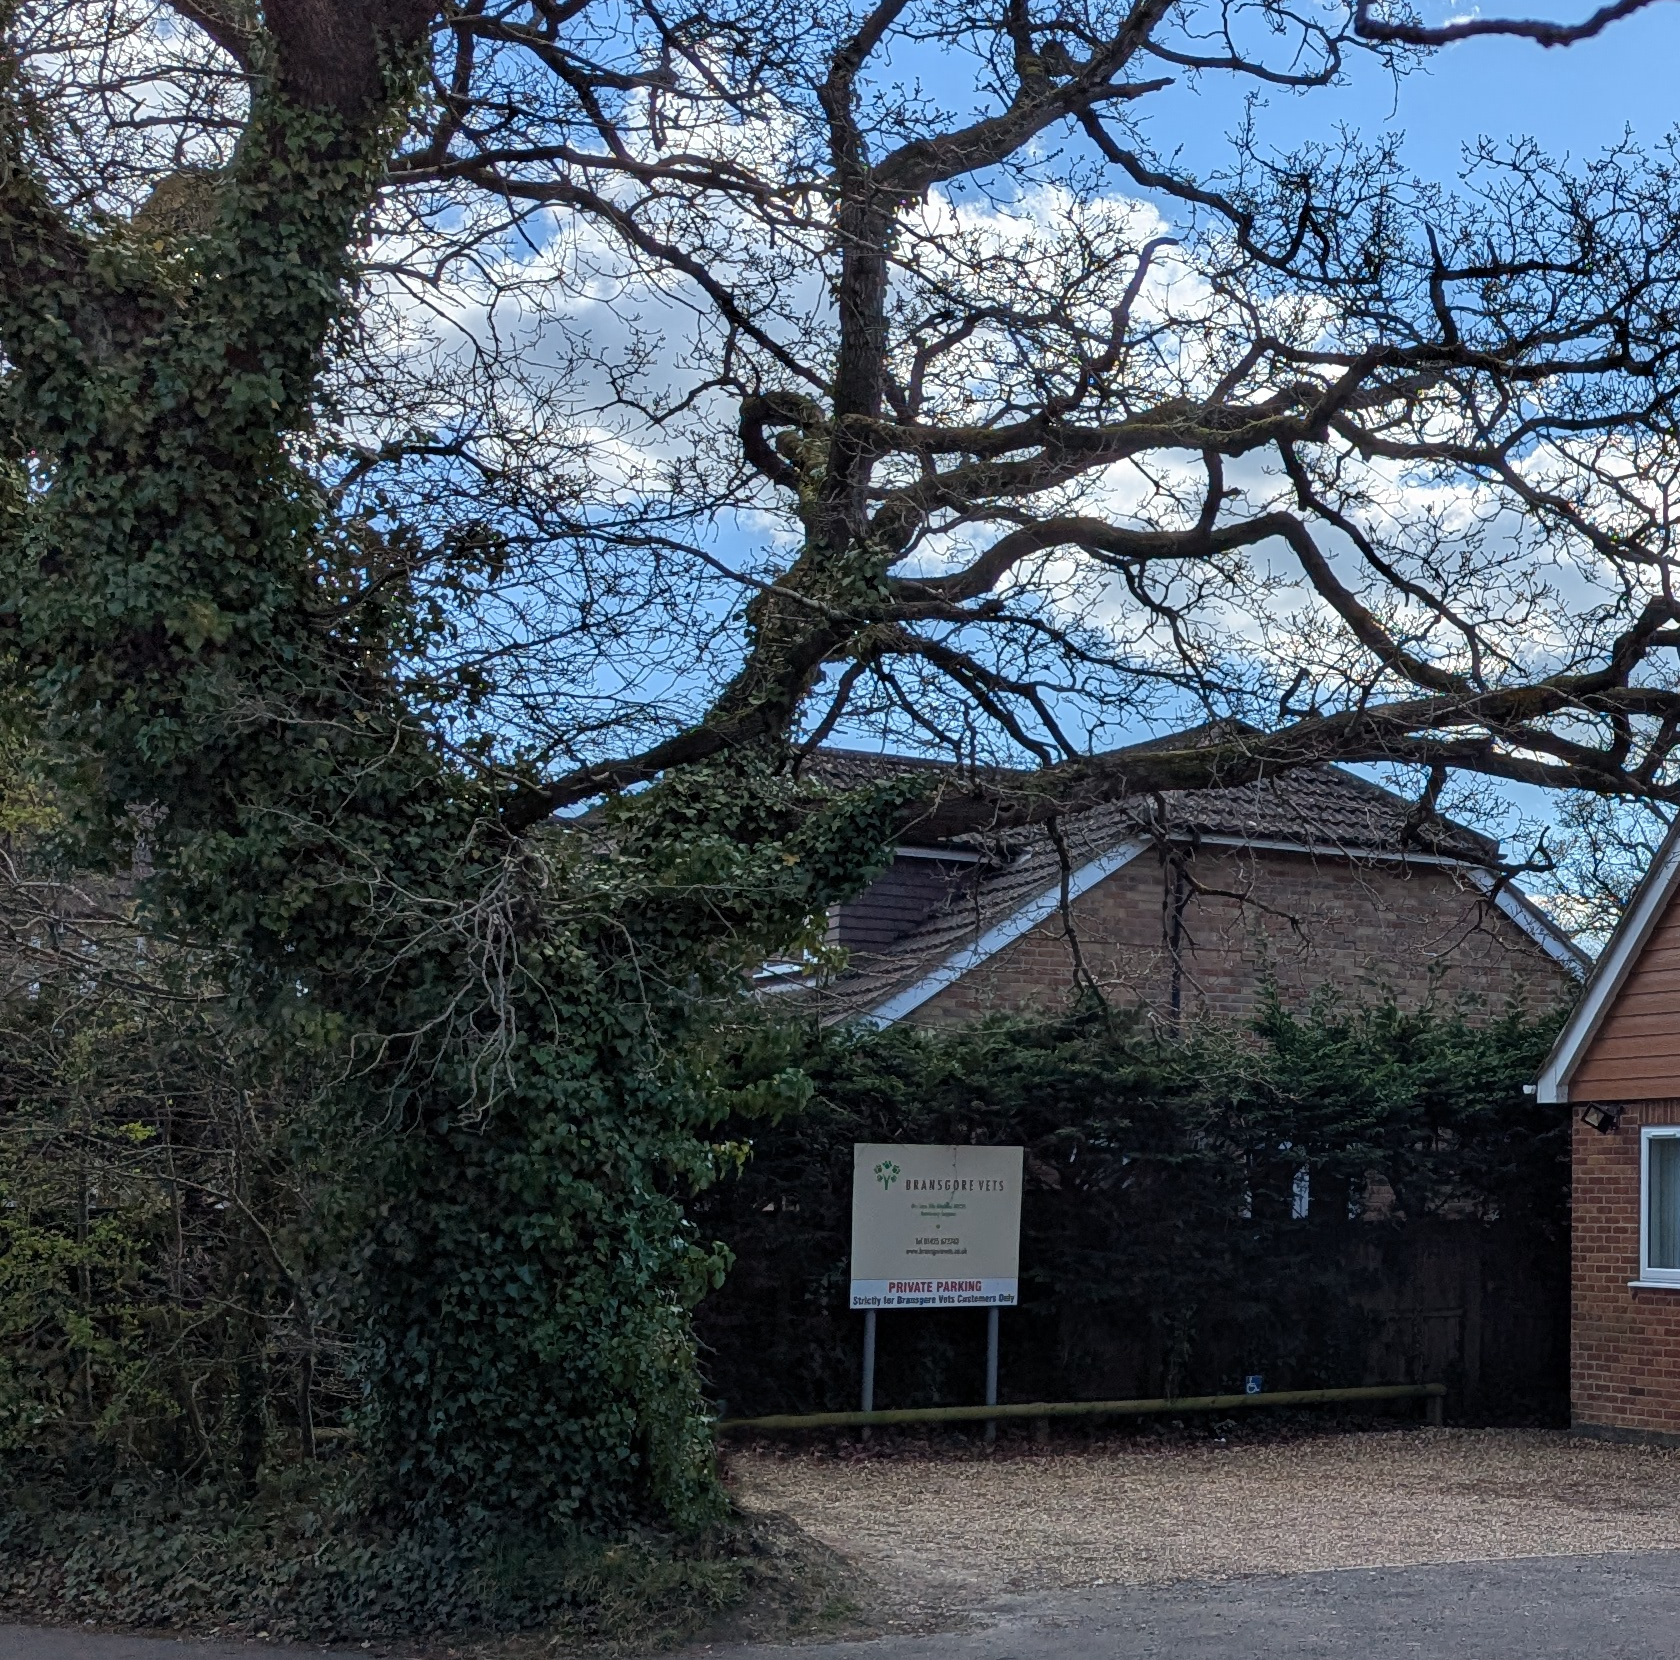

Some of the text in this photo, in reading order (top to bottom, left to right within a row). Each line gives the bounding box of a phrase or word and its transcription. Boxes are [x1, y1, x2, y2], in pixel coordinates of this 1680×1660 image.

[905, 1179, 1004, 1192] BRANSGORE VETS
[888, 1280, 982, 1293] PRIVATE PARKING
[852, 1294, 1015, 1306] Strictly for Bransgore Vets Customers Only
